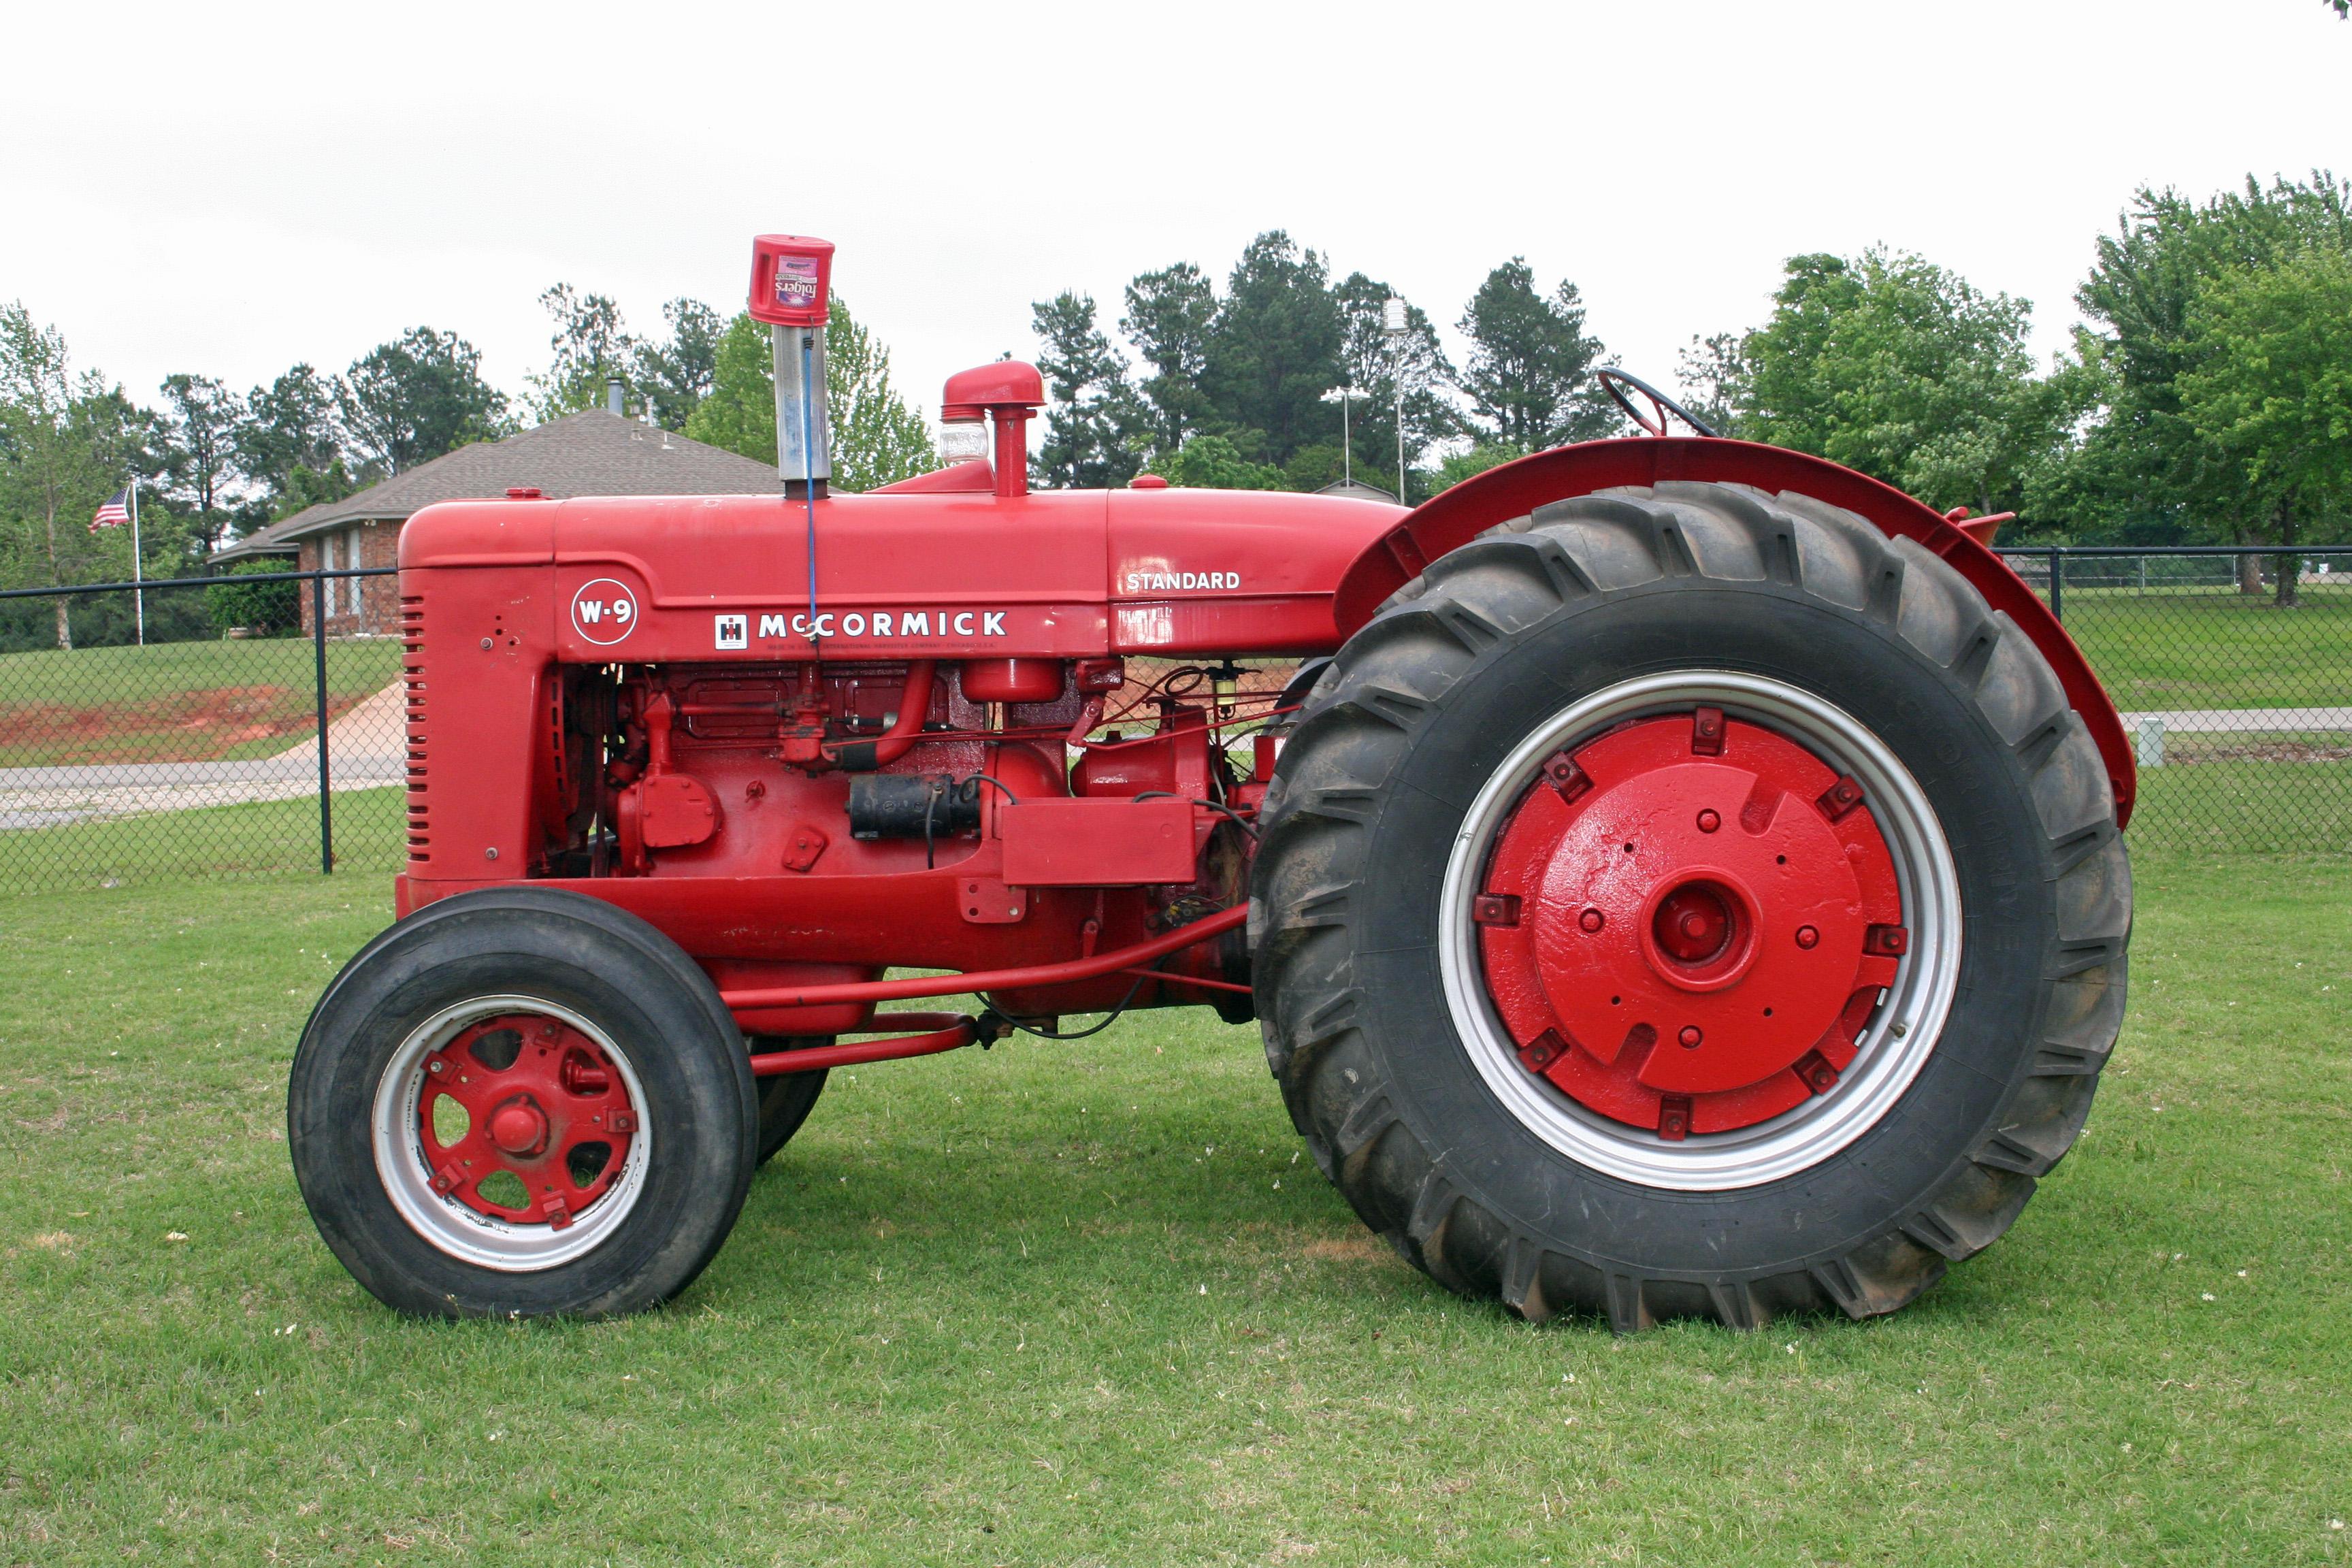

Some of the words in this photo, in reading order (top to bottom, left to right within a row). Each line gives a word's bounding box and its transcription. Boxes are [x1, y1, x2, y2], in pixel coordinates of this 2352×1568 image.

[775, 281, 817, 298] Folgers
[1126, 572, 1240, 590] STANDARD
[578, 599, 632, 623] W-9
